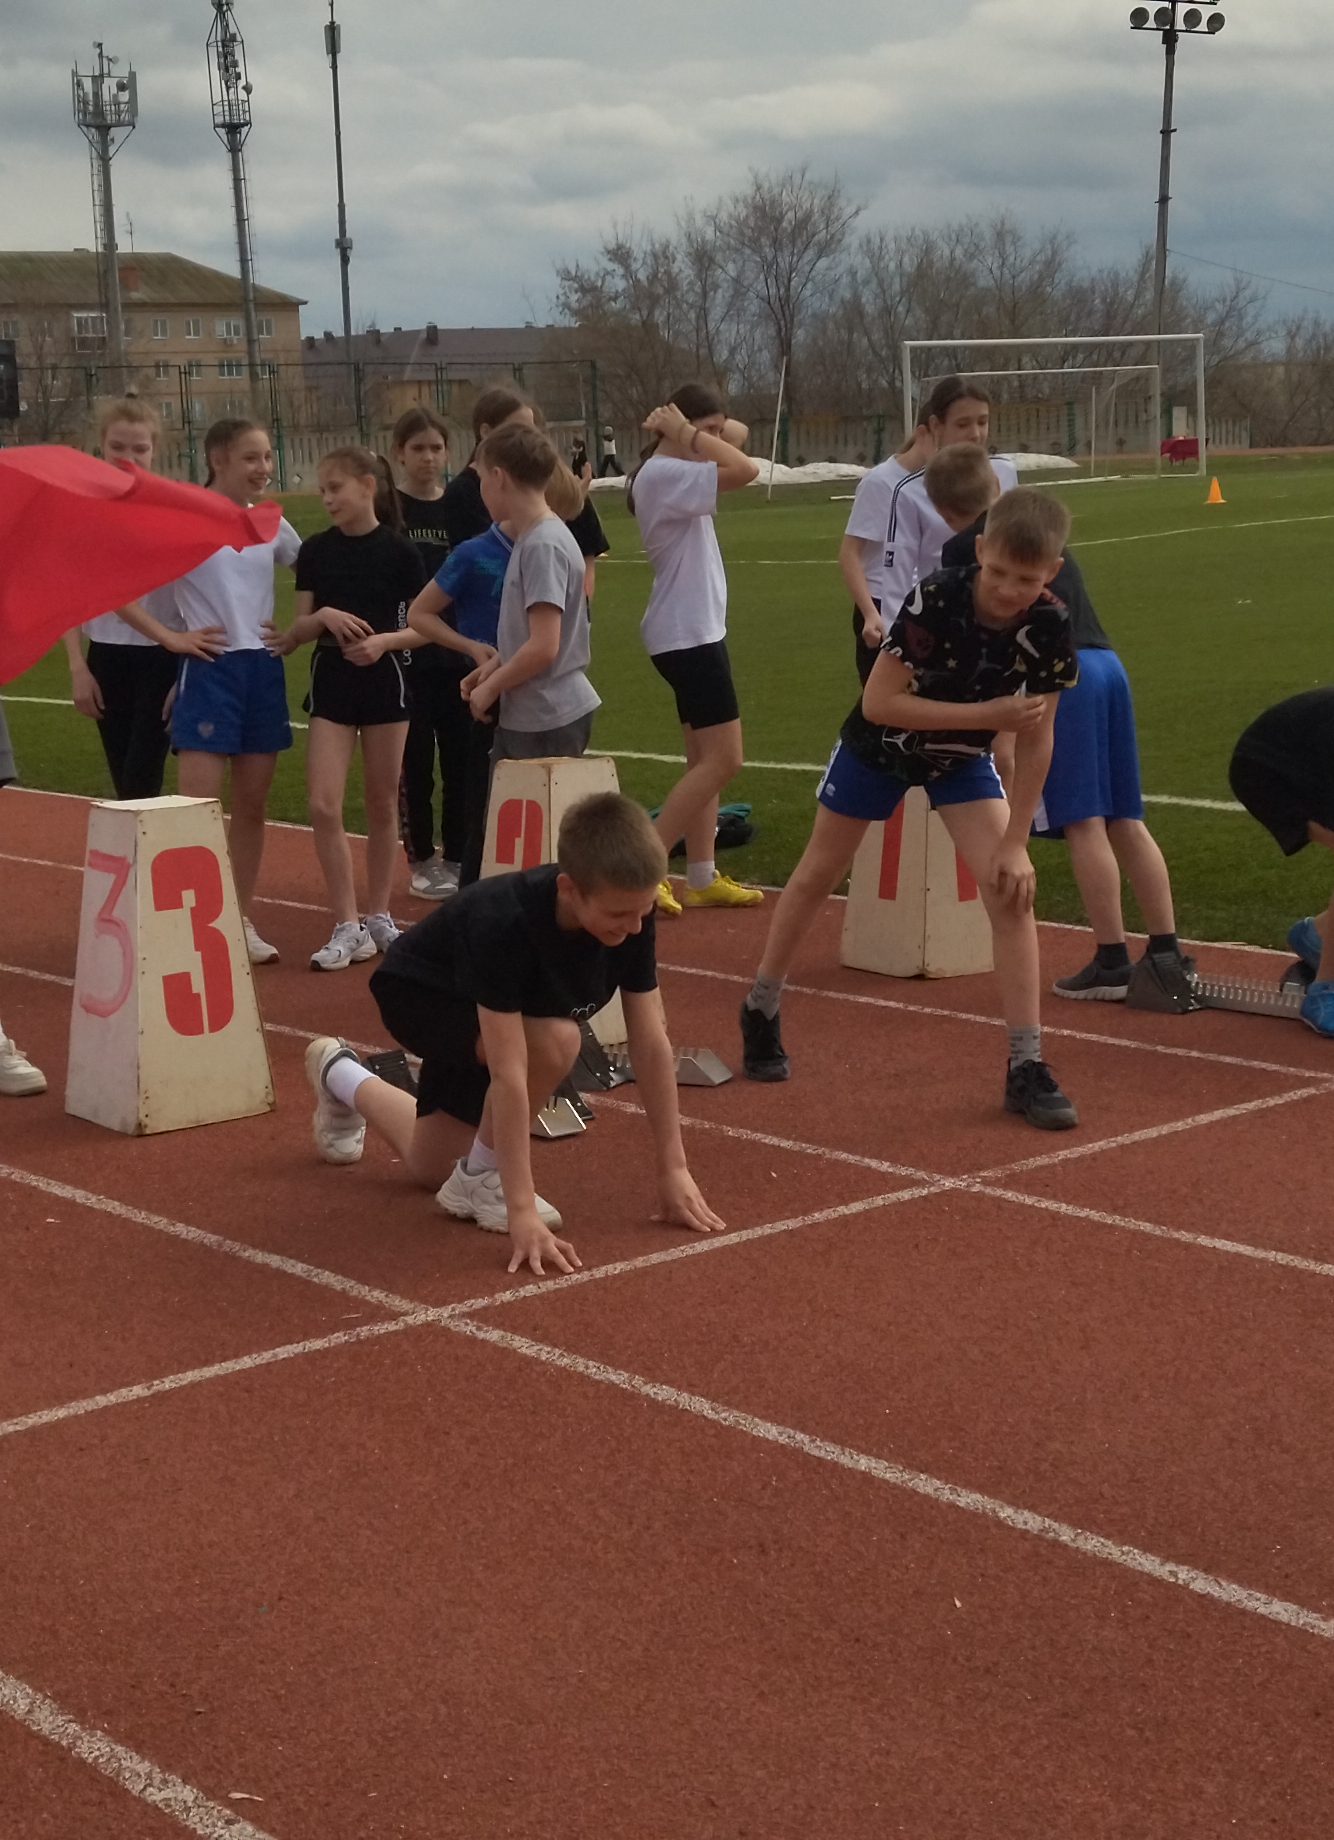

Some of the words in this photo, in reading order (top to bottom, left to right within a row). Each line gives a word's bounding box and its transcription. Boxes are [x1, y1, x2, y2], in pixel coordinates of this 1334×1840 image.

[408, 528, 448, 539] LIFESTYL
[80, 849, 135, 1018] 3
[150, 845, 235, 1037] 3
